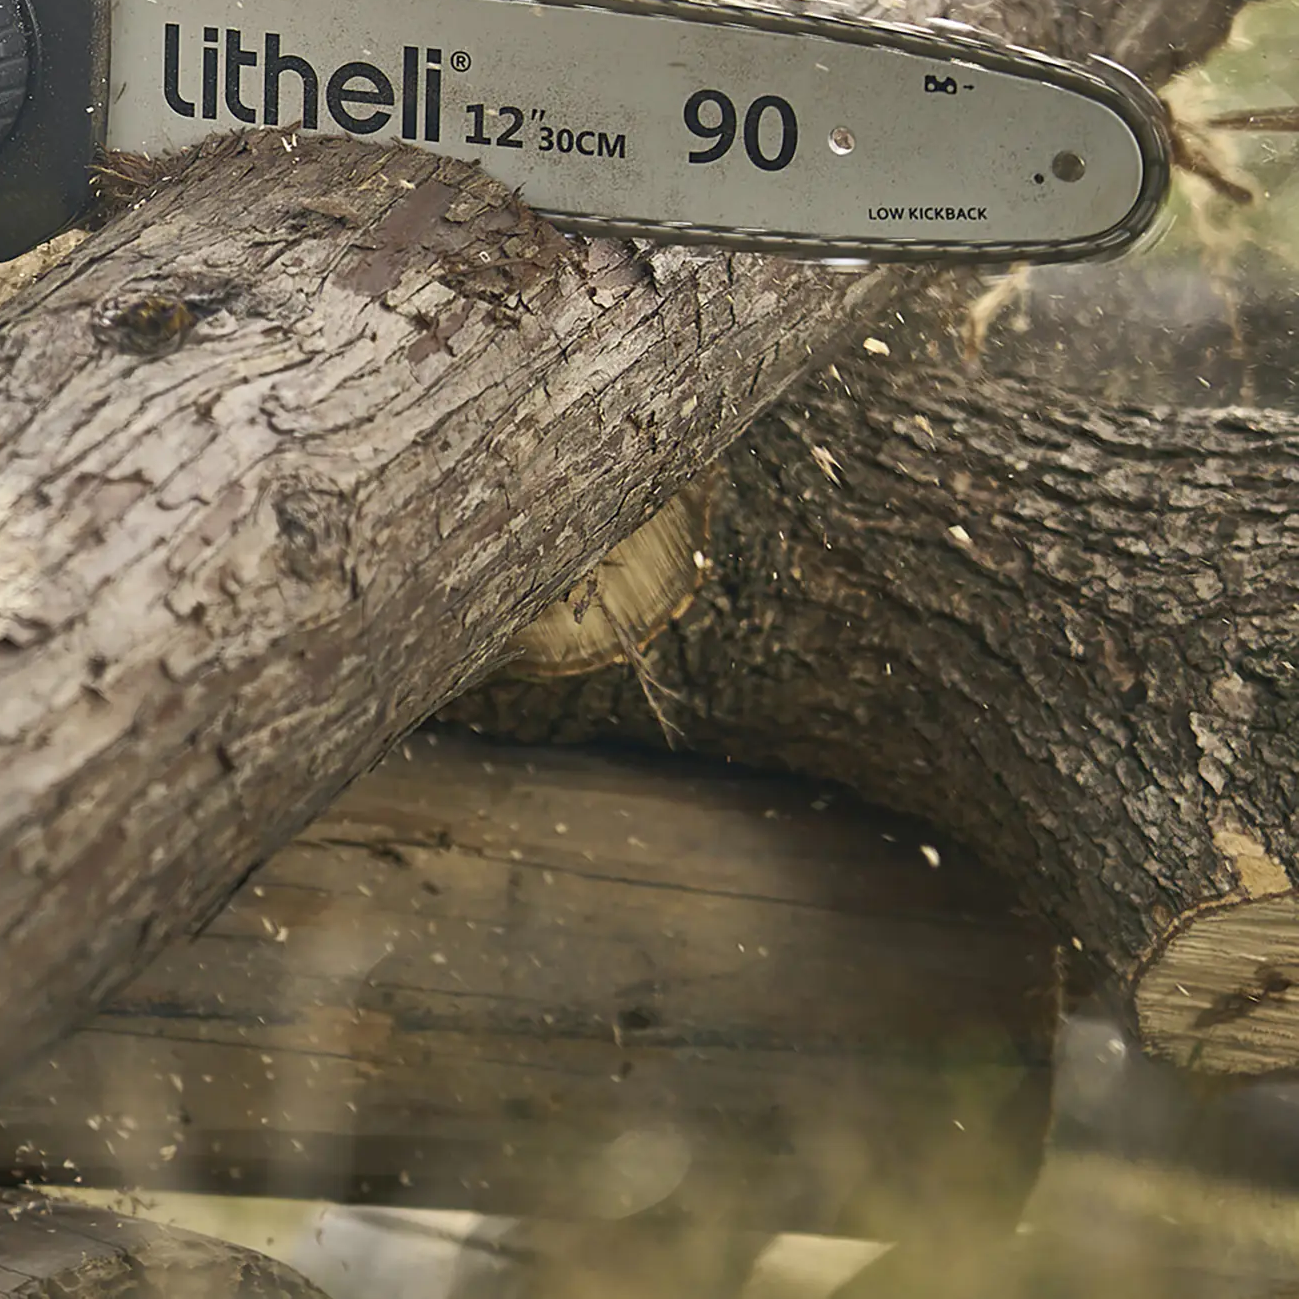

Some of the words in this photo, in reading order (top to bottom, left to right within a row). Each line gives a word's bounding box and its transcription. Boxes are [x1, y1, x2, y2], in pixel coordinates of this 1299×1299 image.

[538, 126, 626, 159] 30CM
[683, 88, 799, 172] 90
[868, 207, 905, 220] LOW
[908, 207, 988, 220] KICKBACK
